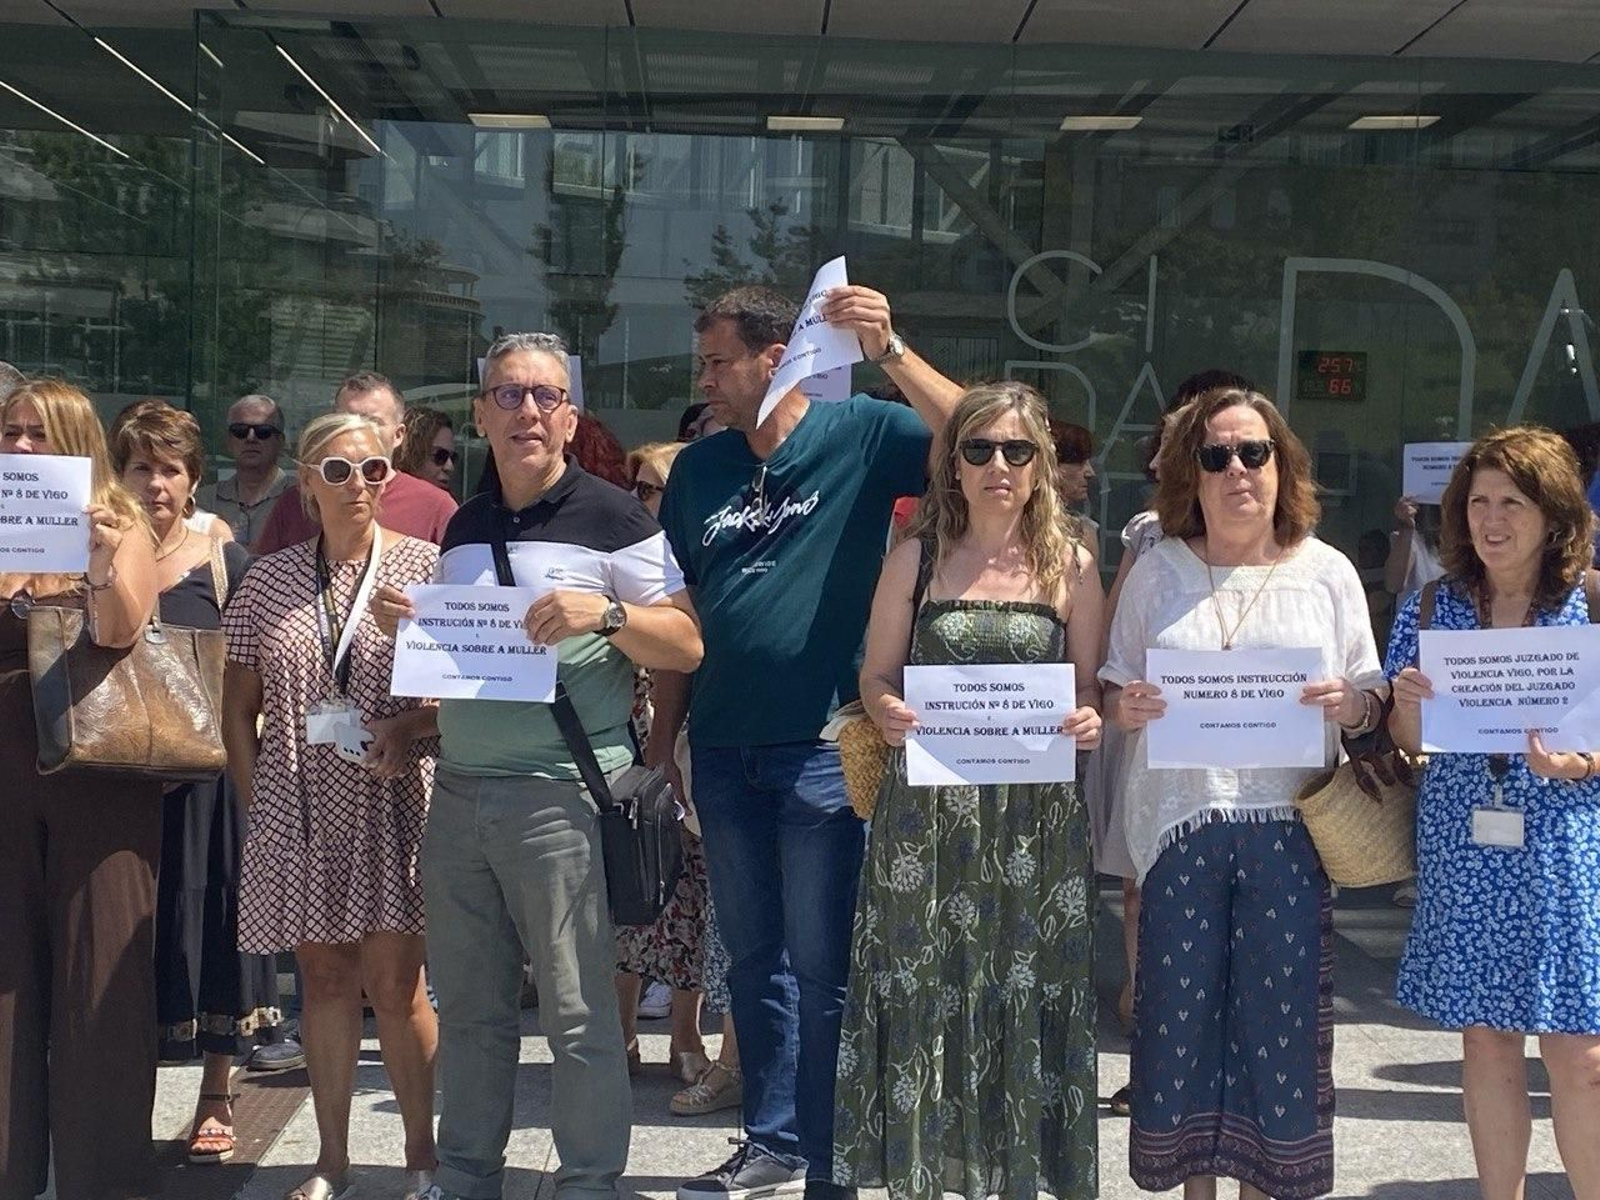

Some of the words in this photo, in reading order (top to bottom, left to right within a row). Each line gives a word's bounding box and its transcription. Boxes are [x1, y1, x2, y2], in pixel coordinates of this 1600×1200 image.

[1008, 250, 1157, 352] CI
[805, 313, 827, 328] MULL
[3, 472, 39, 482] SOMOS
[16, 489, 23, 498] 8
[26, 490, 40, 499] DE
[42, 489, 69, 500] VIGO
[0, 515, 22, 526] BRE
[25, 516, 33, 525] A
[36, 516, 79, 526] MULLER
[444, 602, 475, 611] TODOS
[478, 603, 510, 612] SOMOS
[418, 616, 475, 628] INSTRUCIÓN
[490, 619, 497, 629] 8
[499, 620, 512, 629] DE
[405, 641, 459, 653] VIOLENCIA
[461, 645, 495, 655] SOBRE
[497, 645, 505, 655] A
[507, 646, 547, 656] MULLER
[1444, 656, 1477, 667] TODOS
[1478, 656, 1513, 666] SOMOS
[1515, 653, 1563, 663] JUZGADO
[1566, 652, 1580, 662] DE
[1160, 675, 1196, 684] TODOS
[1197, 674, 1234, 684] SOMOS
[1236, 672, 1307, 683] INSTRUCCIÓN
[1451, 669, 1505, 680] VIOLENCIA
[1506, 668, 1535, 678] VIGO,
[1537, 668, 1557, 677] POR
[1560, 667, 1574, 676] LA
[953, 683, 987, 692] TODOS
[989, 683, 1025, 692] SOMOS
[1451, 682, 1502, 693] CREACIÓN
[1504, 683, 1525, 692] DEL
[1527, 681, 1576, 691] JUZGADO
[1183, 690, 1228, 699] NUMERO
[1231, 689, 1239, 699] 8
[1241, 690, 1256, 698] DE
[1258, 688, 1285, 699] VIGO
[925, 699, 986, 710] INSTRUCIÓN
[1002, 700, 1010, 710] 8
[1012, 701, 1026, 710] DE
[1028, 699, 1055, 710] VIGO
[1459, 697, 1513, 708] VIOLENCIA
[1517, 695, 1559, 706] NÚMERO
[1562, 697, 1569, 705] 2
[915, 726, 971, 736] VIOLENCIA
[973, 726, 1009, 736] SOBRE
[1011, 727, 1020, 736] A
[1022, 726, 1063, 736] MULLER
